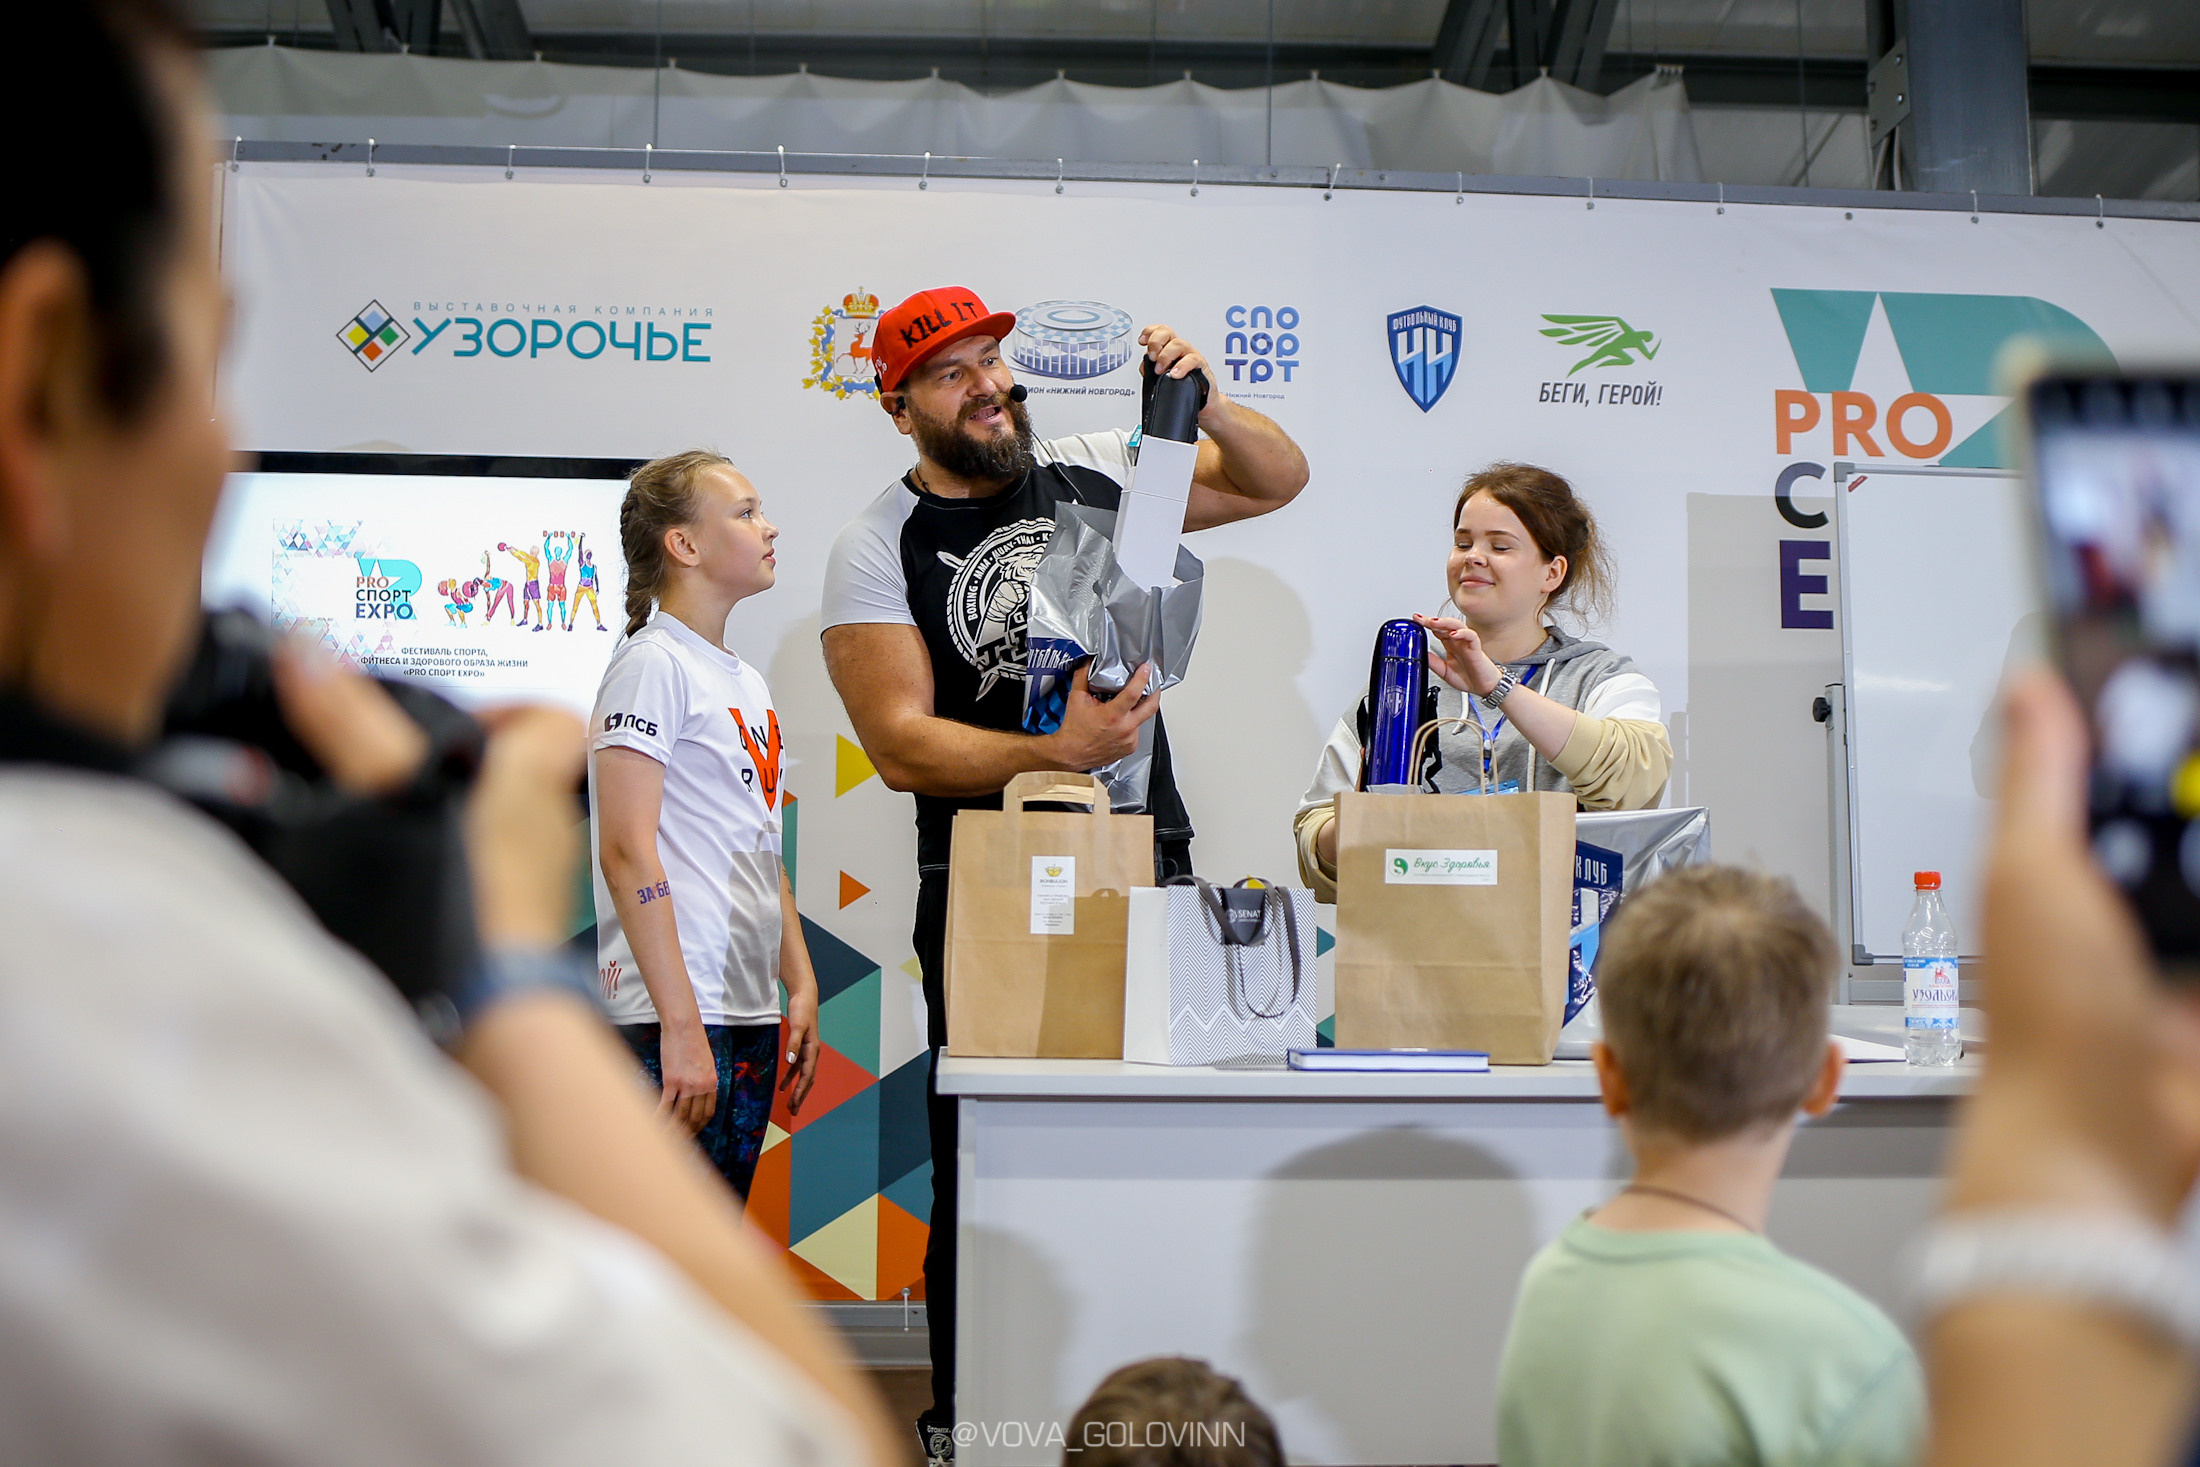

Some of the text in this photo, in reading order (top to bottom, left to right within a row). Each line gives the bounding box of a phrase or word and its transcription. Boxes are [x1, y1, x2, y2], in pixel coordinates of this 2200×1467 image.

[414, 301, 714, 317] ВЫСТАВОЧНАЯ КОМПАНИЯ
[899, 302, 981, 349] KILL IT
[1393, 310, 1457, 333] ФУТБОЛЬНЫЙ КЛУБ
[411, 316, 712, 362] УЗОРОЧЬЕ
[1046, 385, 1088, 396] «НИЖНИЙ
[1089, 386, 1136, 397] НОВГОРОД»
[1253, 392, 1286, 400] Новгород
[1539, 380, 1663, 408] БЕГИ, ГЕРОЙ!
[1775, 389, 1953, 460] PRO
[356, 576, 390, 589] PRO
[966, 585, 979, 621] BOXING
[973, 558, 992, 580] MMA
[991, 535, 1035, 558] MUAY-THAI
[355, 588, 412, 603] СПОРТ
[355, 603, 414, 620] EXPO
[401, 647, 489, 657] ФЕСТИВАЛЬ СПОРТА,
[360, 655, 529, 668] ФИТНЕСА И ЗДОРОВОГО ОБРАЗА ЖИЗНИ
[403, 668, 485, 678] «PRO СПОРТ EXPO»
[624, 713, 658, 737] ПСБ
[741, 767, 783, 794] RU
[1413, 856, 1491, 874] Вкус Здоровья
[1575, 854, 1608, 887] КЛУБ
